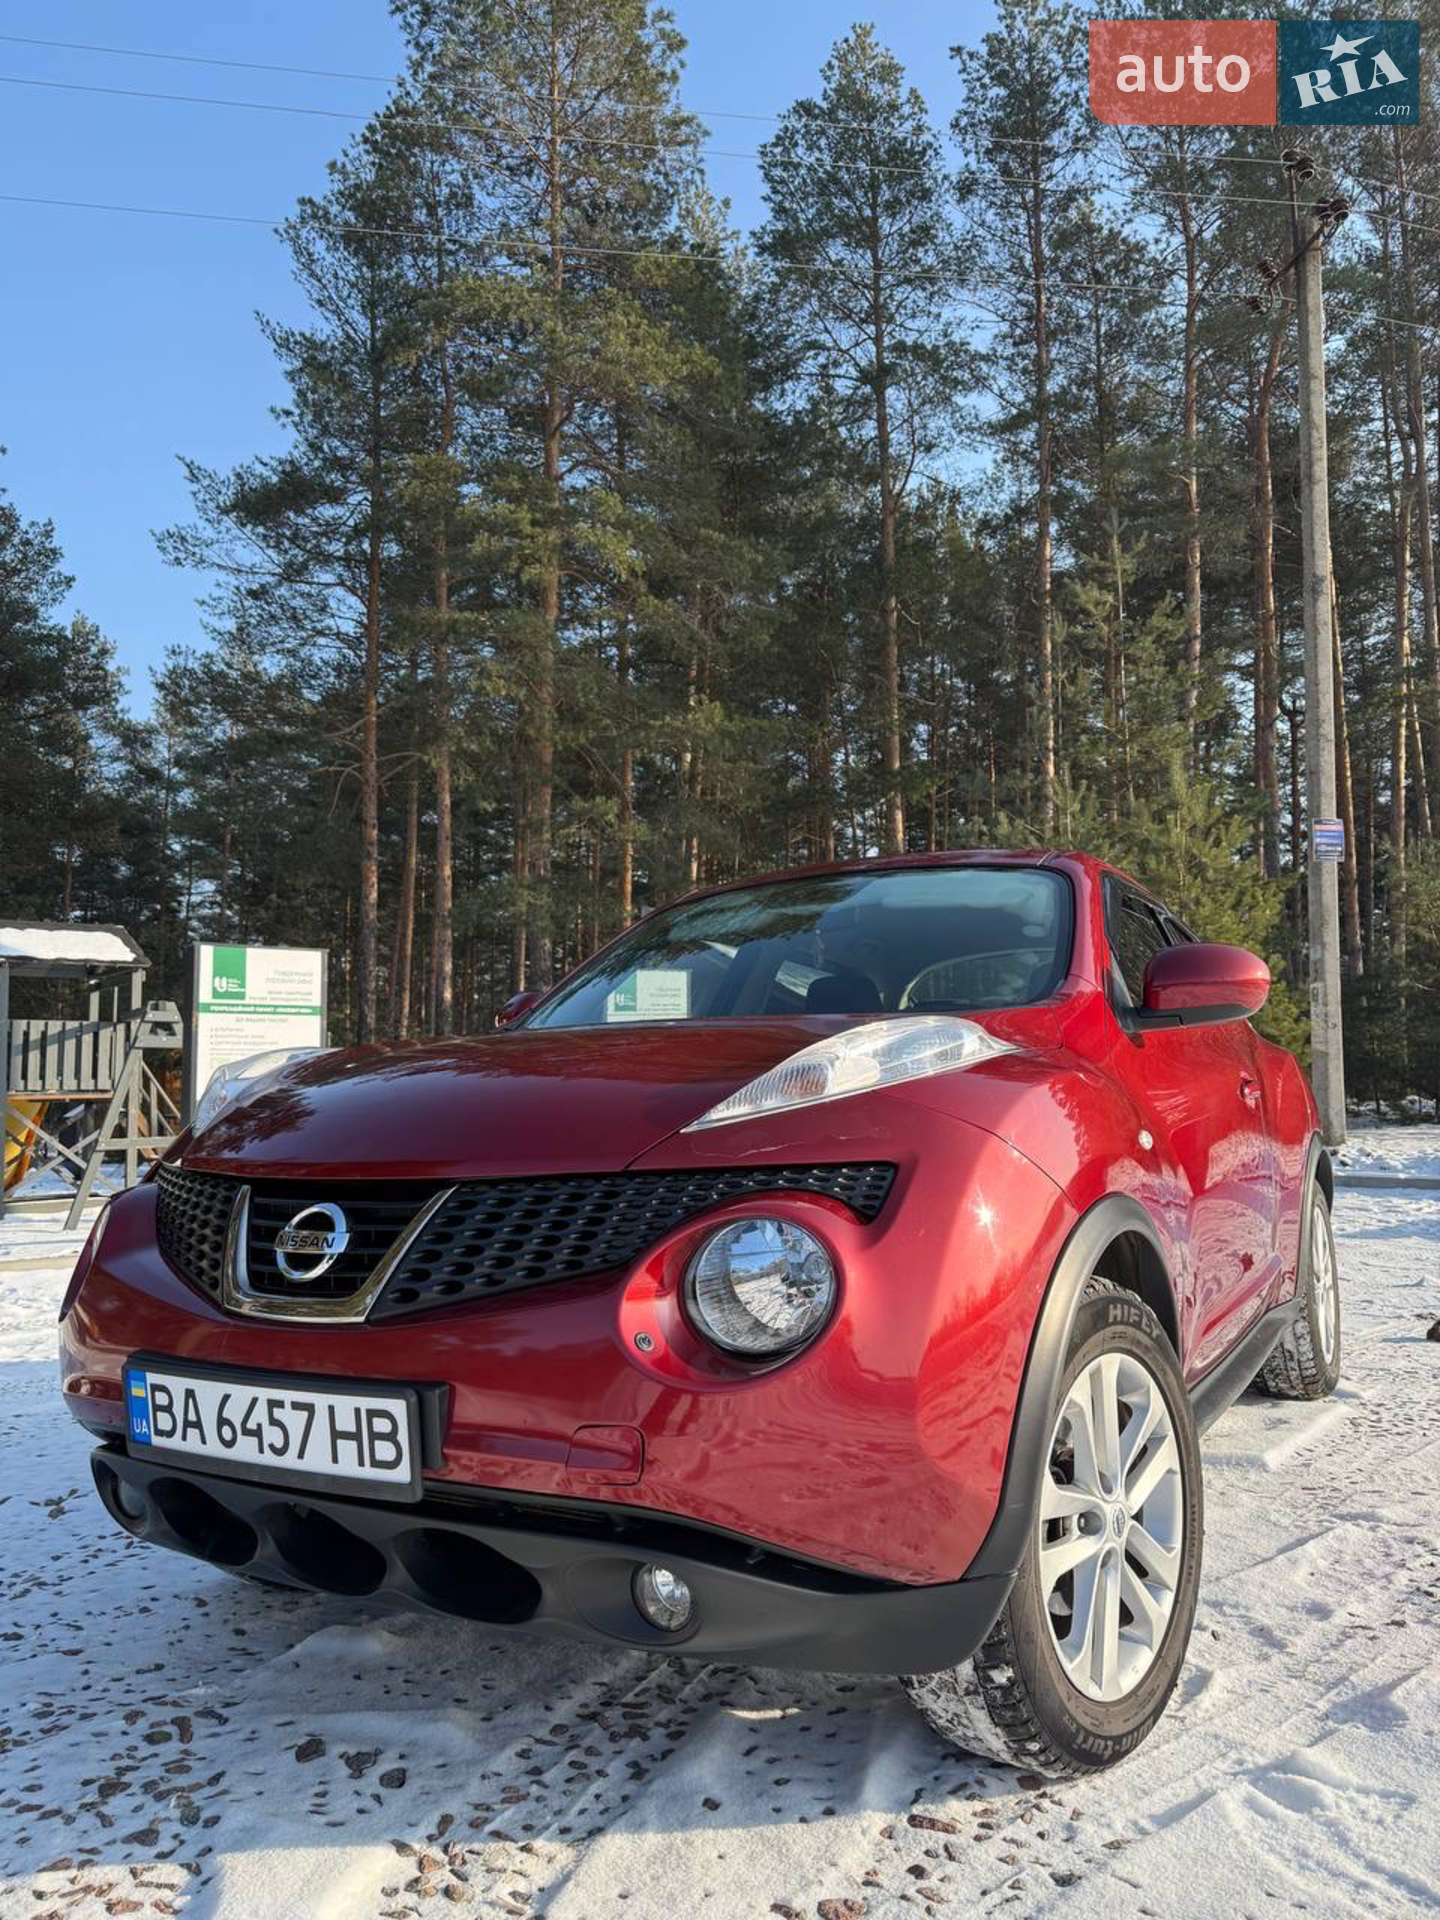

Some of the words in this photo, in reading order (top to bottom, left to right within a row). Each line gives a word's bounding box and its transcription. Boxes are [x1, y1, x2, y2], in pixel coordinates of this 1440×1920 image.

[278, 1235, 335, 1248] NISSAN
[1108, 1303, 1161, 1339] HIFLY
[132, 1418, 149, 1435] UA
[150, 1383, 207, 1445] BA
[216, 1393, 315, 1460] 6457
[328, 1404, 403, 1470] HB
